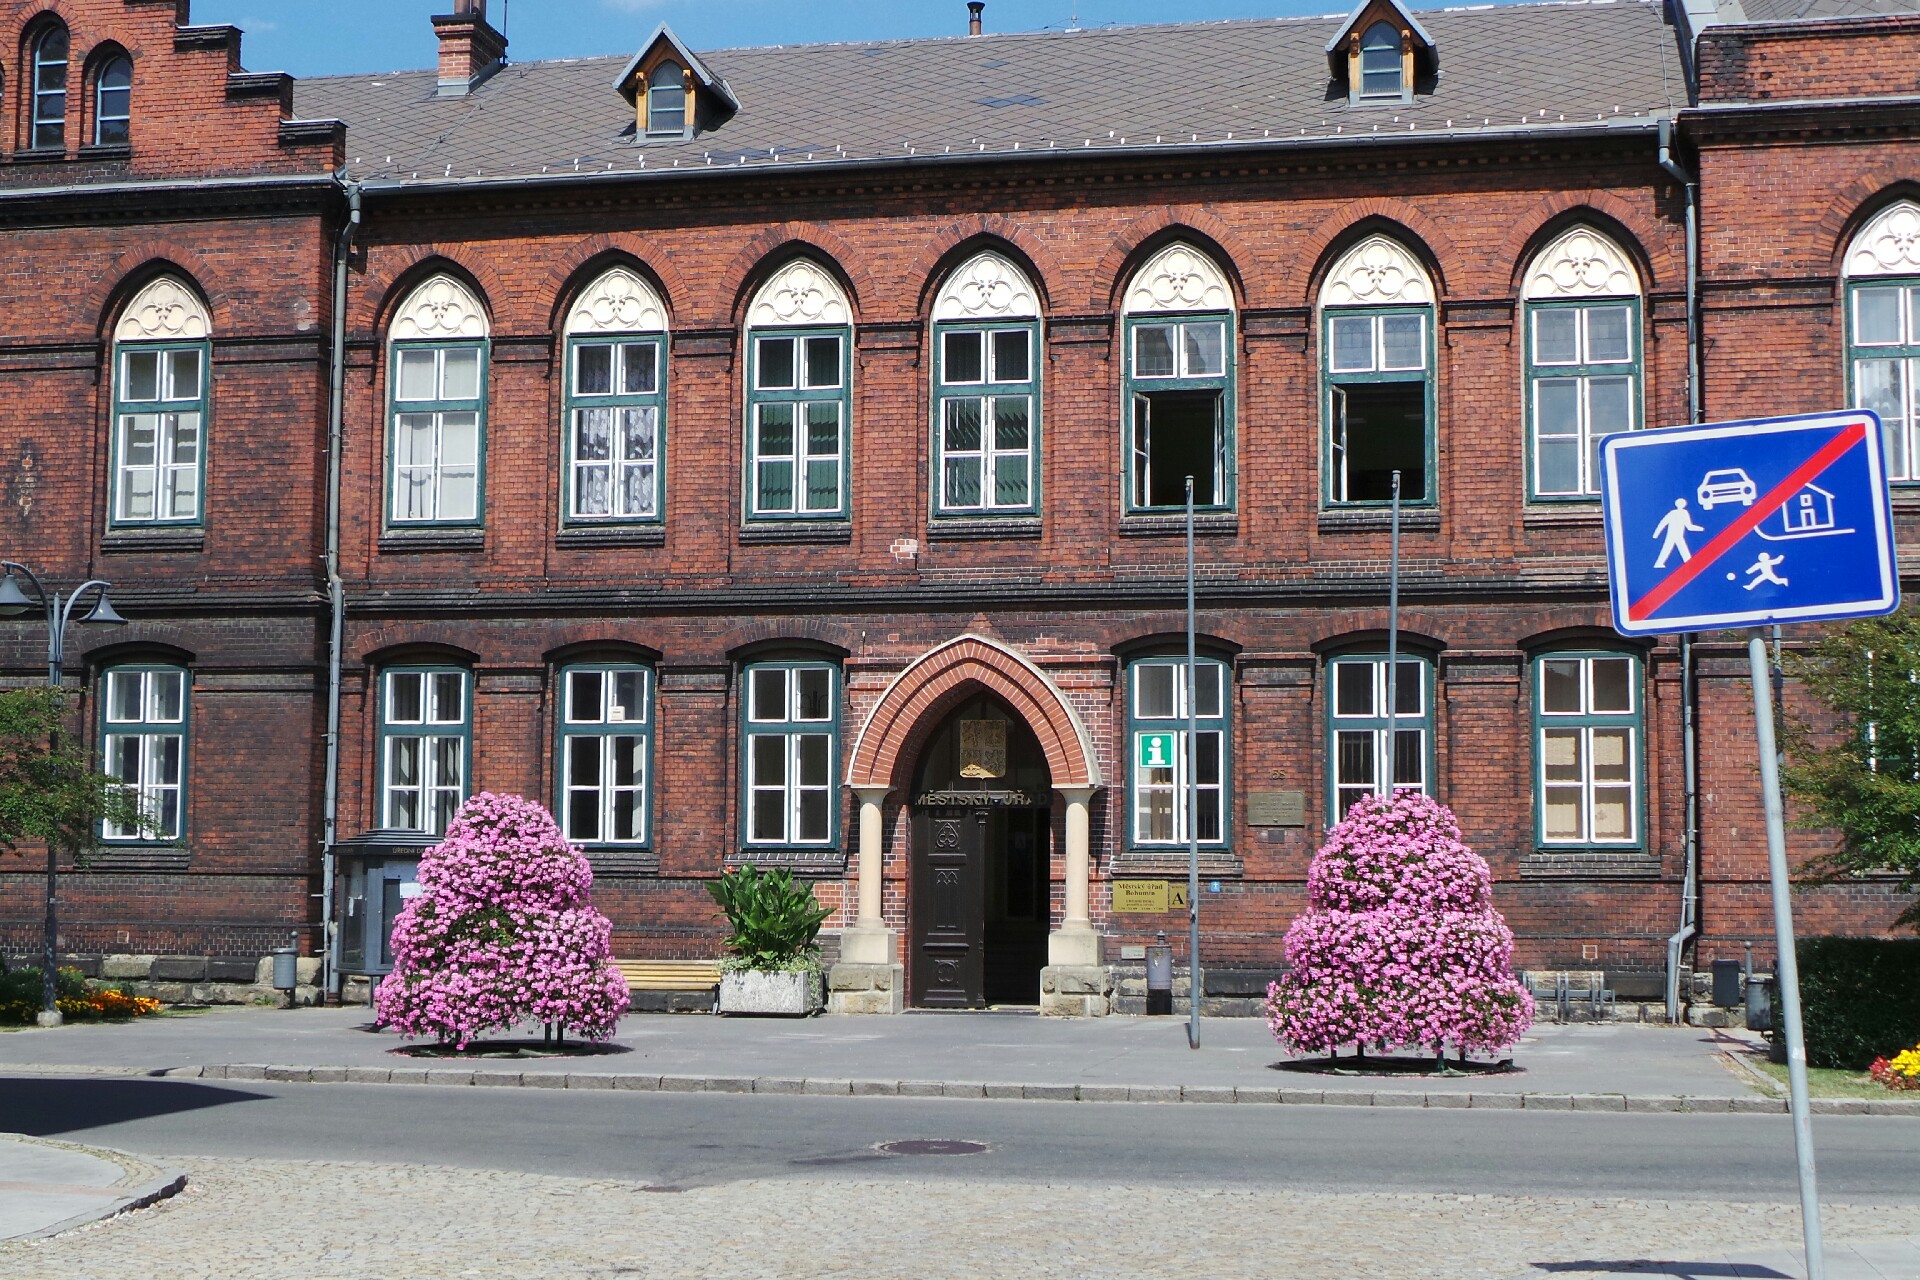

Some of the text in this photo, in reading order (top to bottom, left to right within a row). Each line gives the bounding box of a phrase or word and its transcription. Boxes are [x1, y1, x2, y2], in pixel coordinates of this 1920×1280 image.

[915, 789, 990, 806] MĚSTSKÝ
[1118, 883, 1145, 891] Městský
[1172, 892, 1185, 905] A
